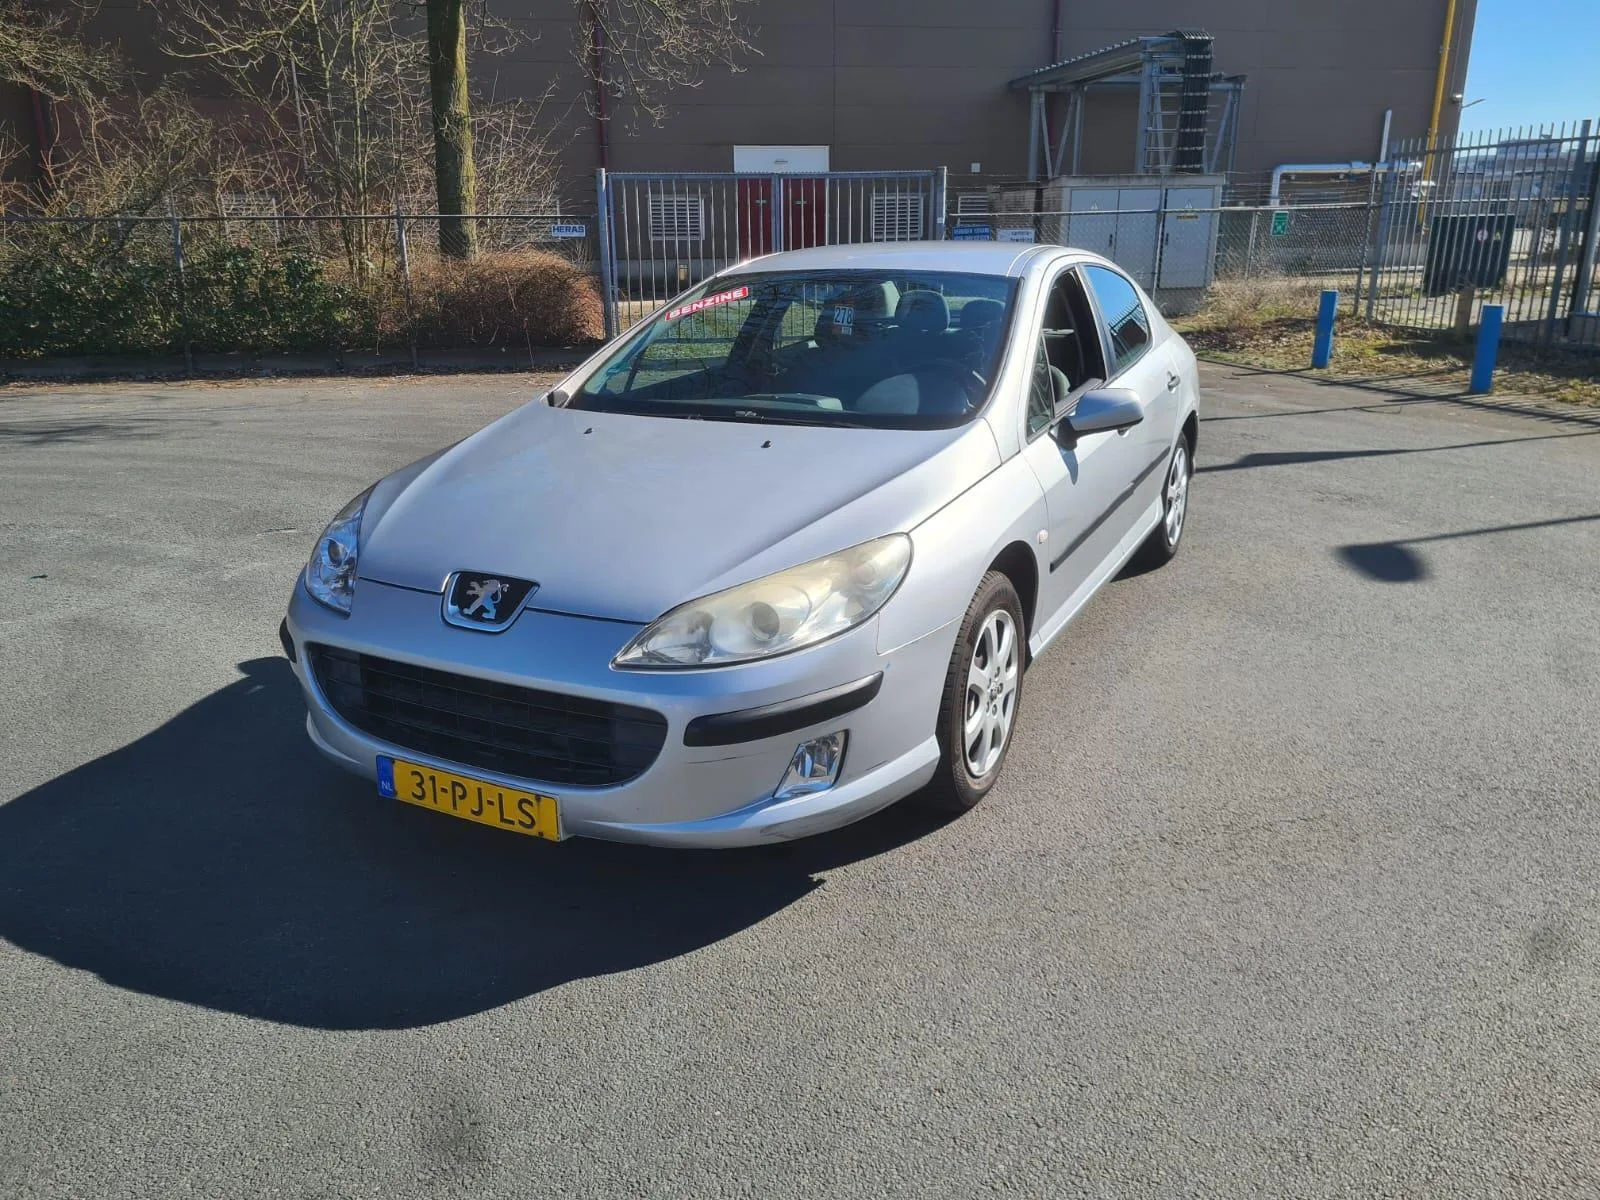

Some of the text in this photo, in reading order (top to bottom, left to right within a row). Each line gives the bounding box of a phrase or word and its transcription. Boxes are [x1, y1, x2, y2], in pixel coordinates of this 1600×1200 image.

[553, 225, 585, 233] HERAS
[669, 288, 744, 318] BENZINE
[381, 780, 393, 791] NL
[411, 770, 536, 829] 31-PJ-LS
